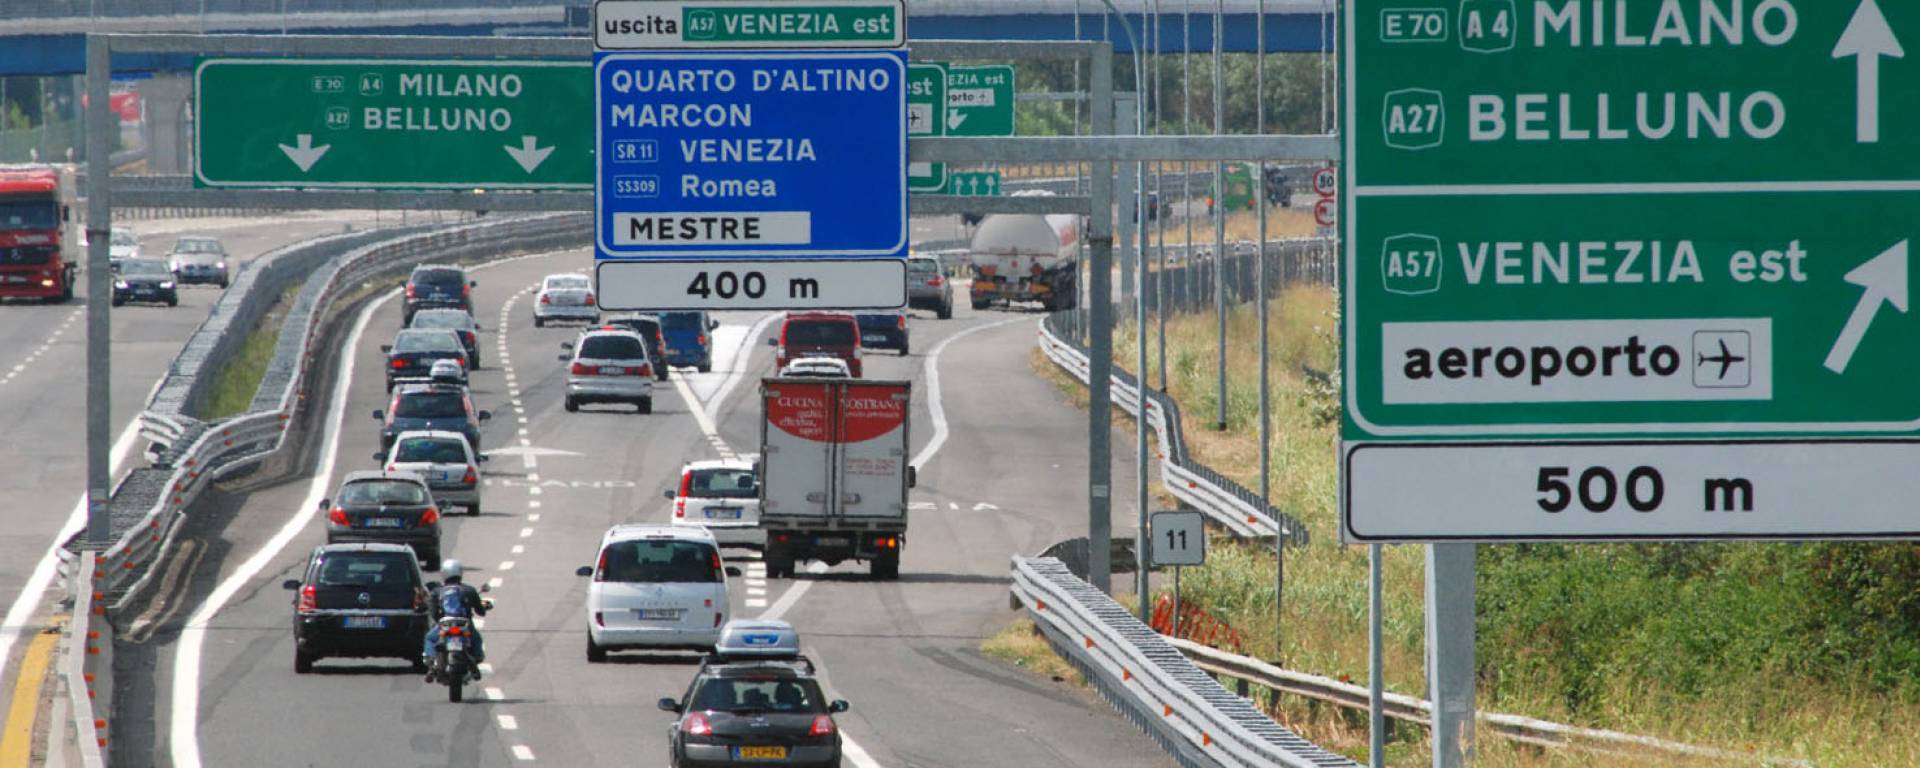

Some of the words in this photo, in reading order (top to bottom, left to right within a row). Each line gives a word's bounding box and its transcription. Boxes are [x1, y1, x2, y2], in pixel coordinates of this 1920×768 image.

[604, 15, 678, 35] uscita
[690, 17, 715, 31] A57
[723, 13, 840, 34] VENEZIA
[852, 13, 890, 34] est
[1534, 0, 1798, 46] MILANO
[399, 73, 523, 98] MILANO
[611, 69, 736, 94] QUARTO
[752, 68, 890, 92] D'ALTINO
[908, 77, 933, 96] st
[984, 72, 1005, 85] est
[327, 111, 348, 125] A27
[363, 107, 512, 131] BELLUNO
[611, 104, 752, 128] MARCON
[1388, 103, 1439, 134] A27
[1468, 90, 1786, 141] BELLUNO
[617, 143, 636, 159] SR
[639, 143, 652, 159] 11
[680, 138, 817, 163] VENEZIA
[616, 179, 656, 193] SS309
[681, 174, 777, 198] Romea
[629, 216, 761, 241] MESTRE
[1387, 249, 1436, 279] A57
[1457, 240, 1704, 285] VENEZIA
[1728, 239, 1809, 283] est
[686, 270, 767, 300] 400
[789, 277, 819, 299] m
[1402, 335, 1681, 386] aeroporto
[1536, 465, 1665, 513] 500
[1704, 476, 1754, 512] m
[1166, 529, 1187, 550] 11
